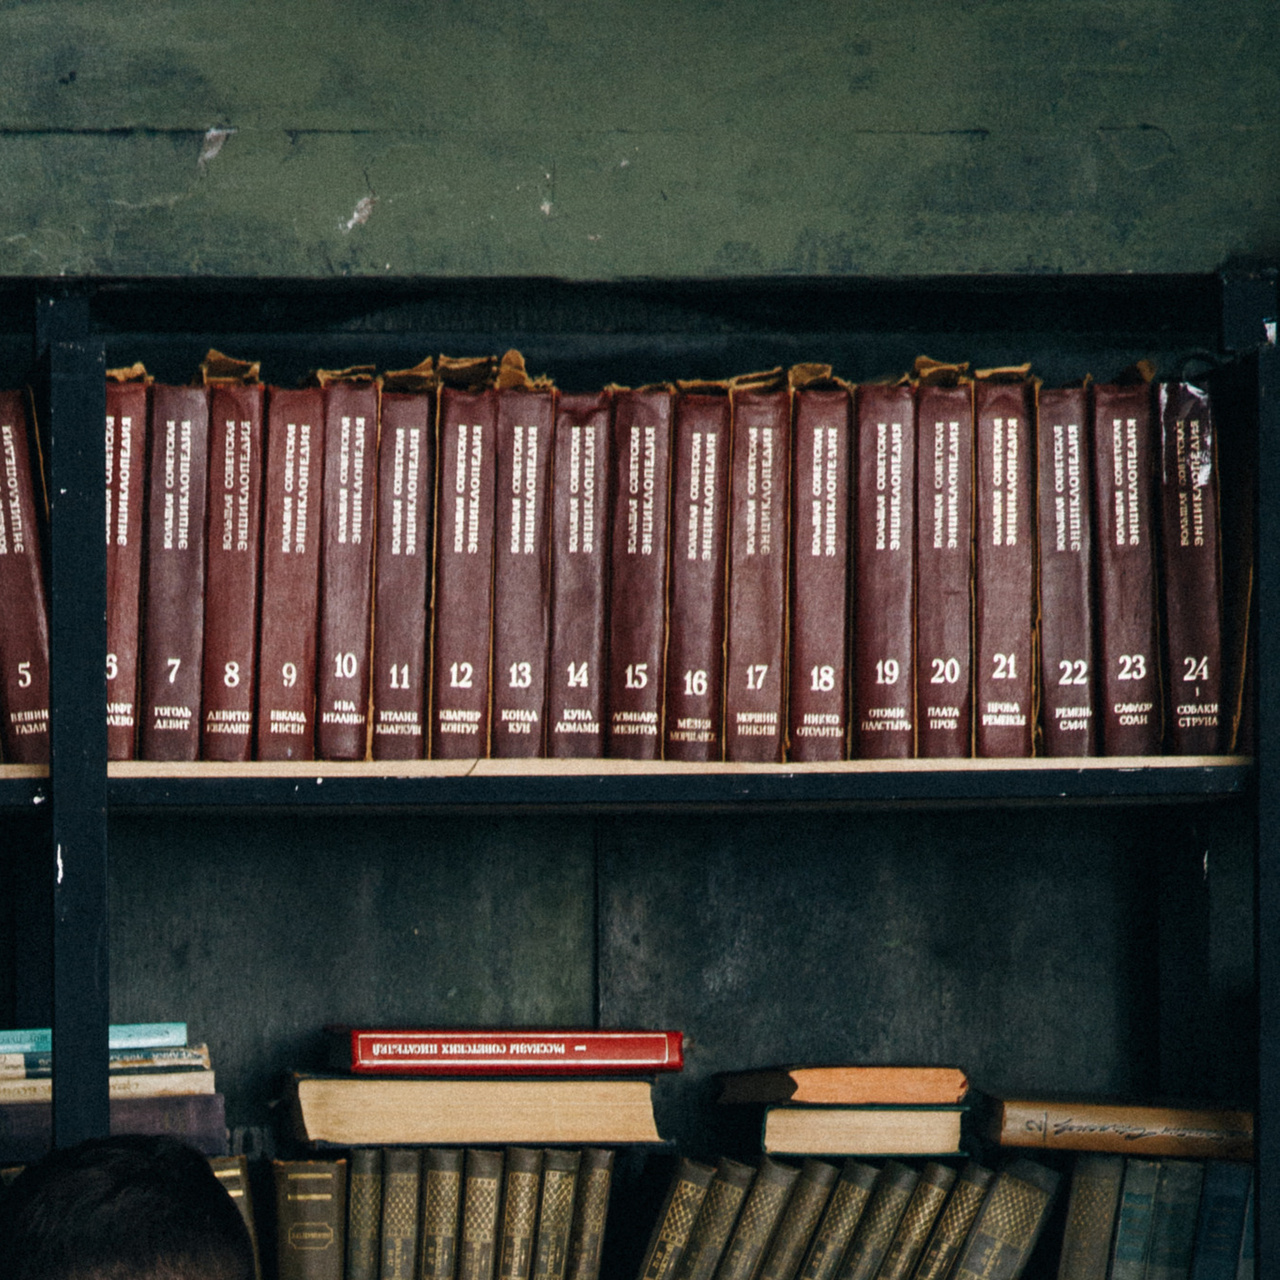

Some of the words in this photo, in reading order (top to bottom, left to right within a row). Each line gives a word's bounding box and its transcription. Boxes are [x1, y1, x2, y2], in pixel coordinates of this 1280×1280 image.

[284, 424, 296, 493] СОВЕТСКАЯ
[812, 428, 824, 497] СОВЕТСКАЯ
[992, 418, 1003, 487] СОВЕТСКАЯ
[177, 419, 192, 550] ЭНЦИКЛОПЕДИЯ
[295, 425, 311, 554] ЭНЦИКЛОПЕДИЯ
[467, 425, 483, 554] ЭНЦИКЛОПЕДИЯ
[523, 426, 538, 555] ЭНЦИКЛОПЕДИЯ
[825, 427, 838, 557] ЭНЦИКЛОПЕДИЯ
[1006, 418, 1018, 546] ЭНЦИКЛОПЕДИЯ
[1126, 418, 1140, 546] ЭНЦИКЛОПЕДИЯ
[18, 661, 32, 688] 5
[167, 658, 181, 684] 7
[223, 661, 240, 688] 8
[282, 662, 297, 688] 9
[334, 652, 358, 679] 10
[389, 663, 410, 689] 11
[450, 662, 473, 689] 12
[509, 662, 532, 688] 13
[567, 661, 589, 688] 14
[625, 663, 648, 689] 15
[746, 664, 768, 690] 17
[810, 665, 835, 692] 18
[876, 658, 900, 685] 19
[930, 657, 961, 684] 20
[992, 653, 1017, 679] 21
[1058, 659, 1088, 685] 22
[1117, 654, 1146, 680] 23
[1183, 656, 1208, 681] 24
[684, 669, 708, 696] 16
[154, 706, 192, 718] ГОГОЛЬ
[501, 709, 539, 723] КОНДА
[563, 709, 593, 721] КУНА
[803, 713, 840, 725] НИККО
[927, 706, 960, 718] ПЛАТА
[1176, 703, 1219, 715] СОБАКИ
[154, 718, 190, 731] ДЕБИТ
[270, 722, 305, 734] ИБСЕН
[508, 722, 531, 734] КУН
[554, 721, 600, 734] ЛОМАМИ
[929, 718, 958, 730] ПРОБ
[371, 1043, 439, 1056] ПИСАТЕЛЕЙ
[441, 1043, 507, 1055] СОВЕТСКИХ
[509, 1043, 566, 1055] РАССКАЗЫ
